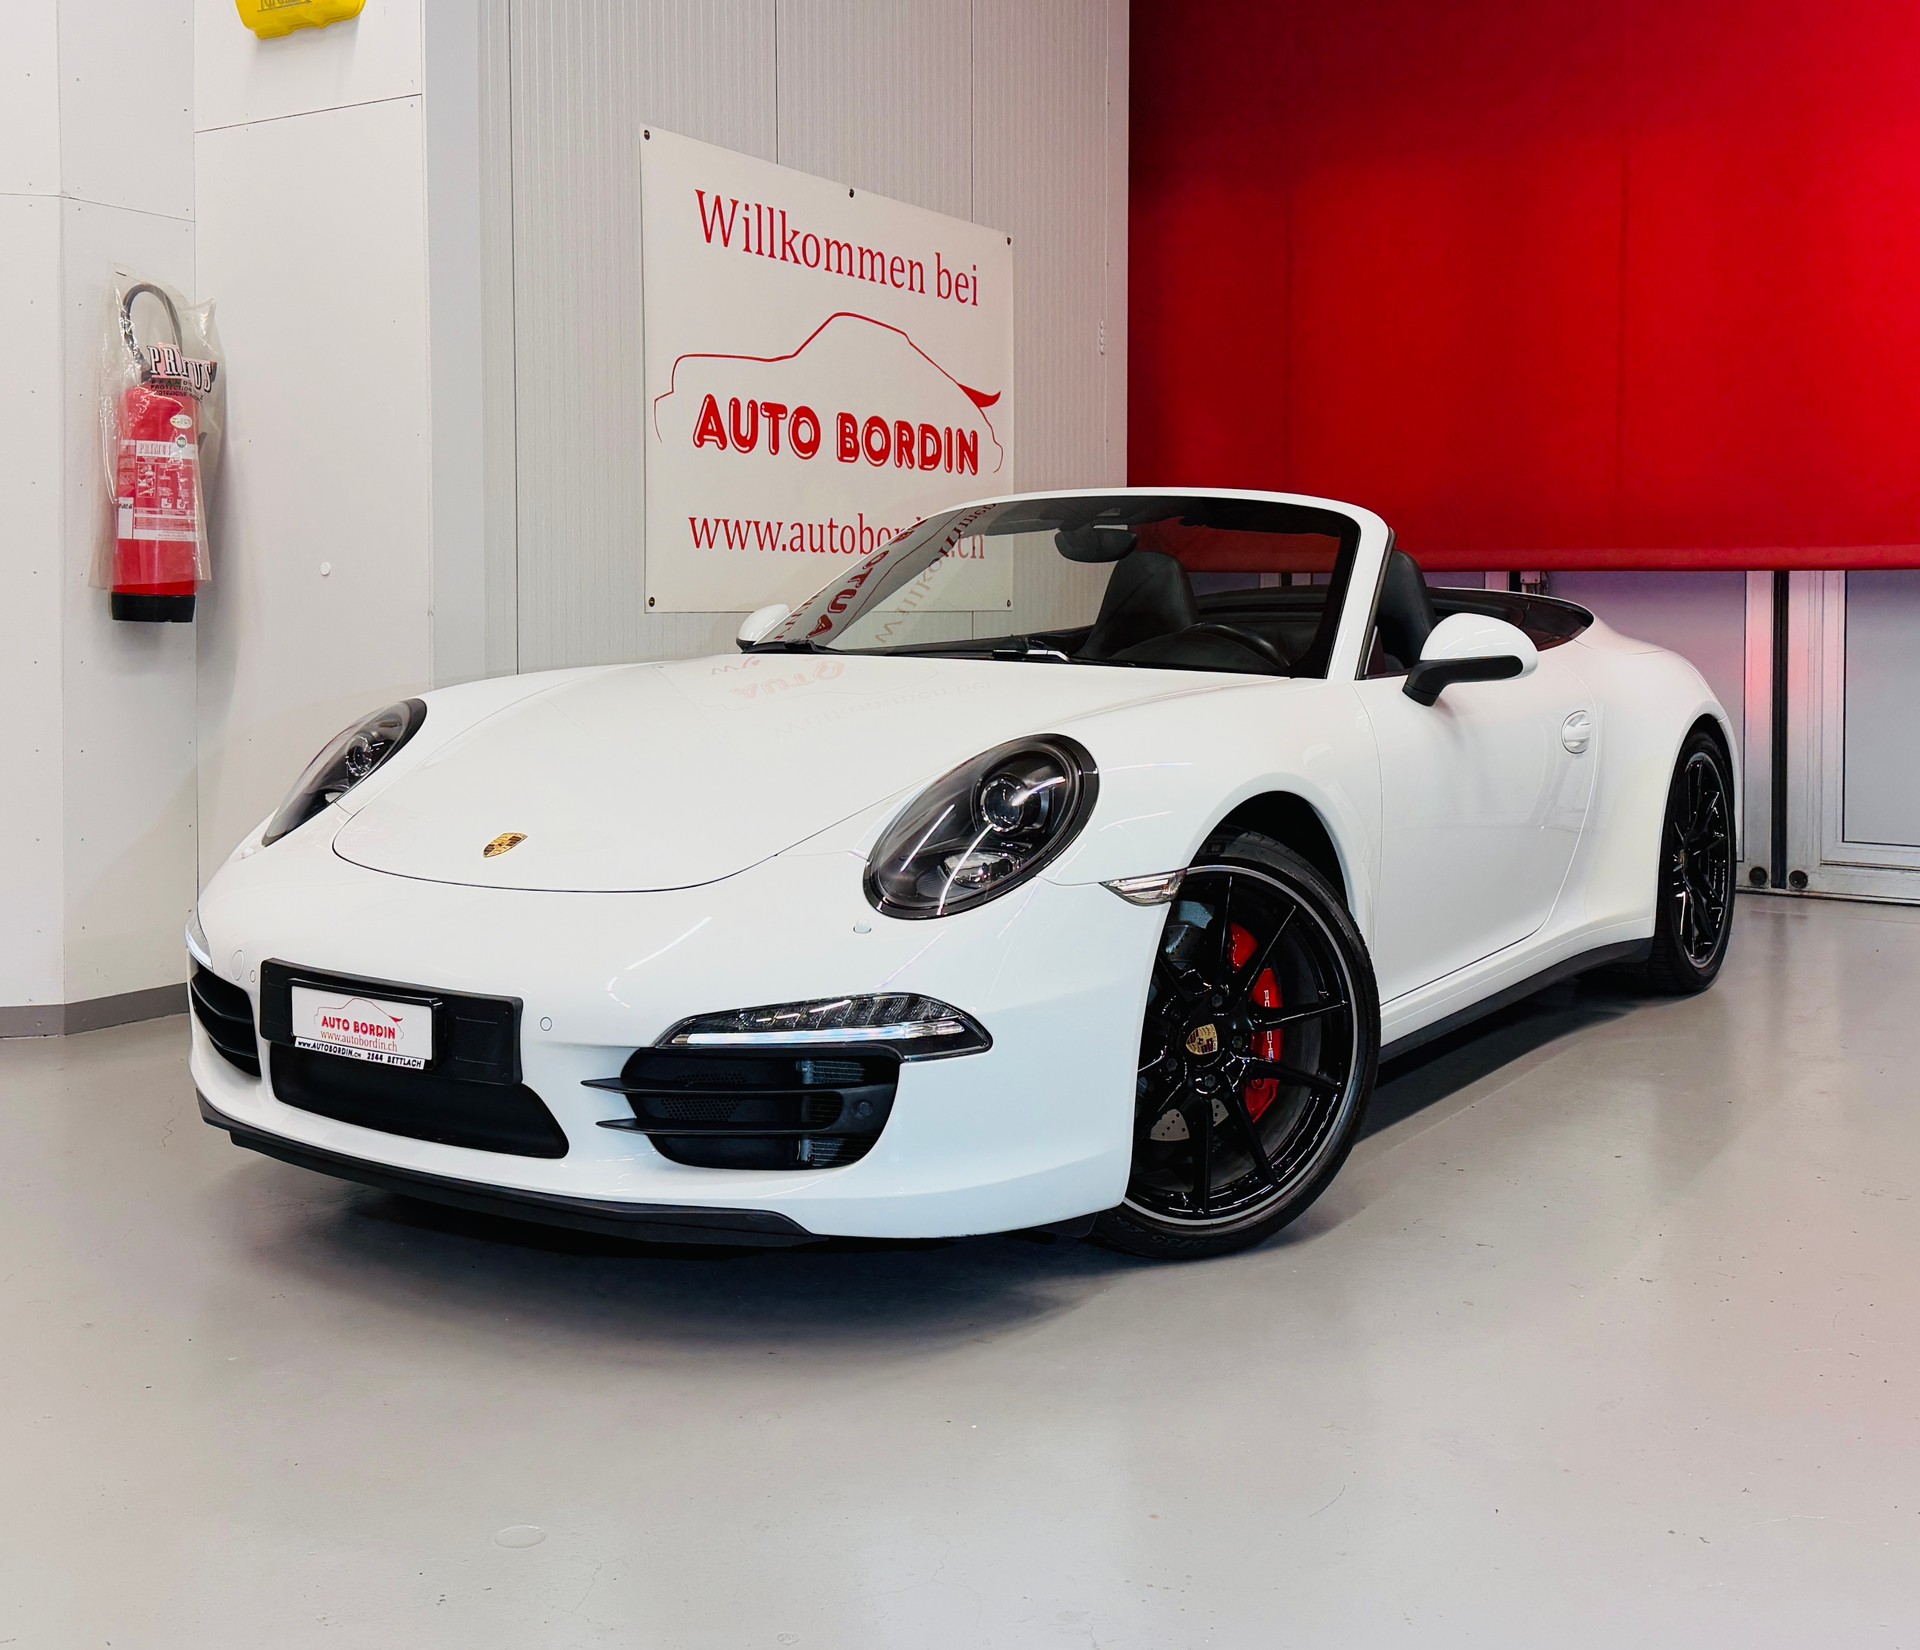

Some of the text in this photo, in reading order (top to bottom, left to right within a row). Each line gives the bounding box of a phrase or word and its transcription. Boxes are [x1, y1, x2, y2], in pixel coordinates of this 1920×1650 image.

[694, 188, 981, 309] Willkommen bei
[692, 393, 980, 476] AUTO BORDIN
[321, 1015, 397, 1040] AUTO BORDIN
[320, 1030, 398, 1053] www.autobordin.ch
[387, 1057, 422, 1068] BETTLACH
